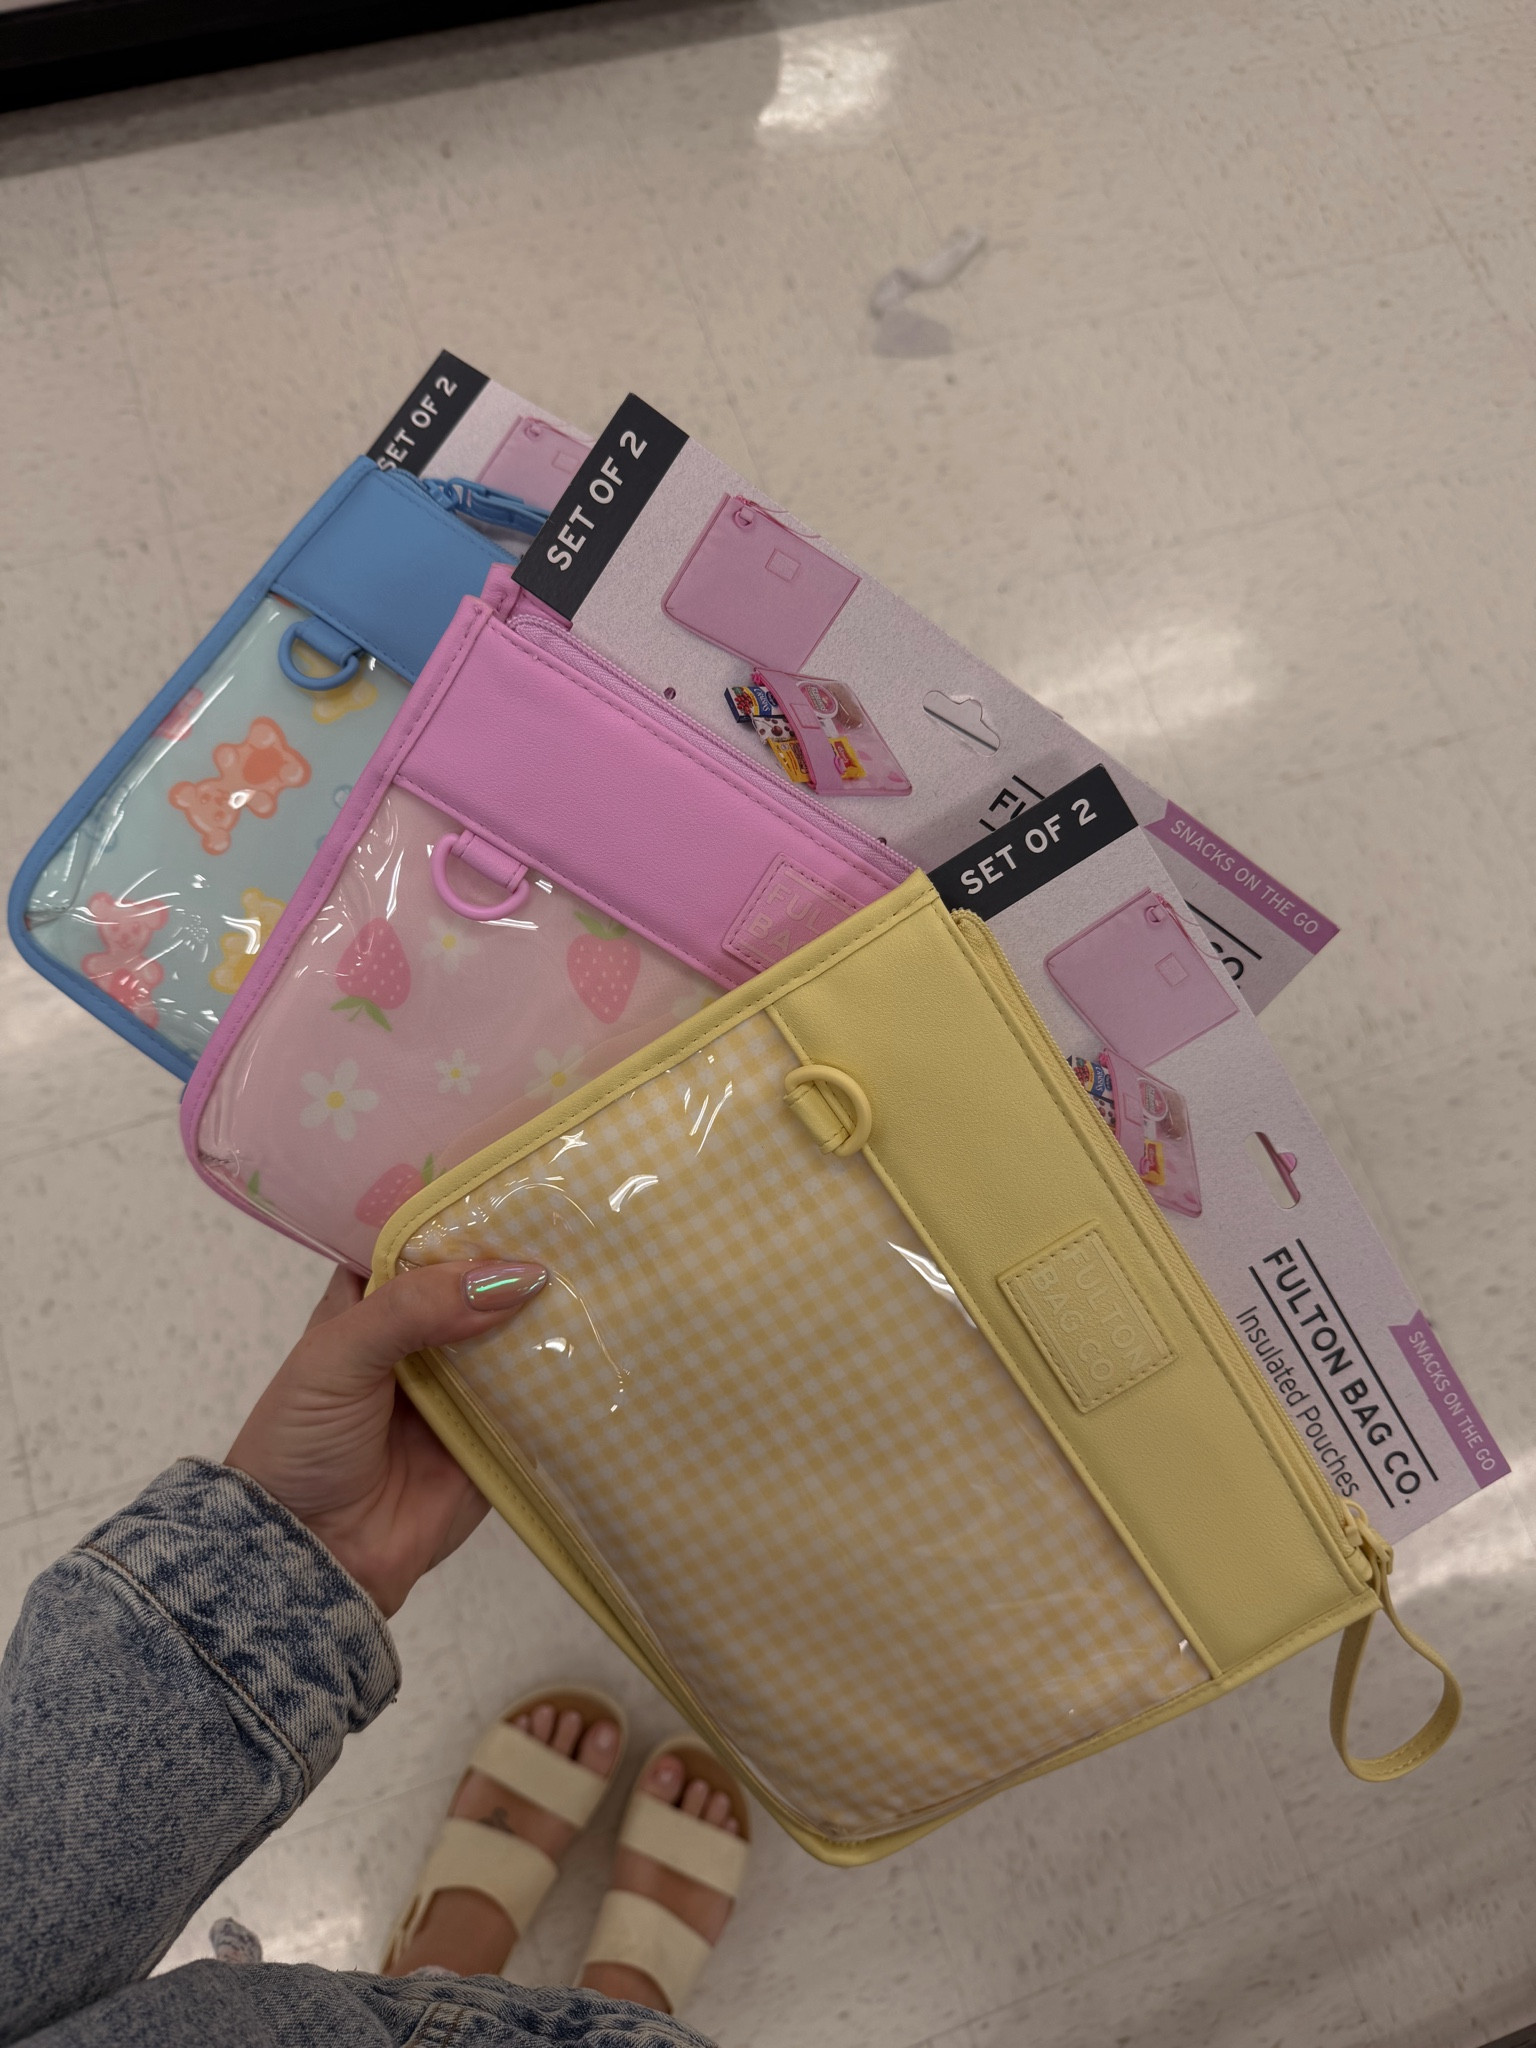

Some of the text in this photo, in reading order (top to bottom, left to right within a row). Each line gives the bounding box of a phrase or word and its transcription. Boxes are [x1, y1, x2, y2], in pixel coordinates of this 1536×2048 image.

[377, 376, 458, 471] SET OF 2
[547, 430, 648, 572] SET OF 2
[960, 844, 1017, 895] SET
[1025, 813, 1061, 853] OF
[1070, 798, 1097, 827] 2
[1170, 819, 1319, 935] SNACKS ON THE GO
[767, 883, 837, 935] FUL
[1030, 1265, 1085, 1333] BAG
[1062, 1248, 1151, 1373] FULTON
[1236, 1305, 1360, 1498] Insulated Pouches
[1262, 1246, 1421, 1504] FULTON BAG CO.
[1408, 1330, 1496, 1471] SNACKS ON THE GO
